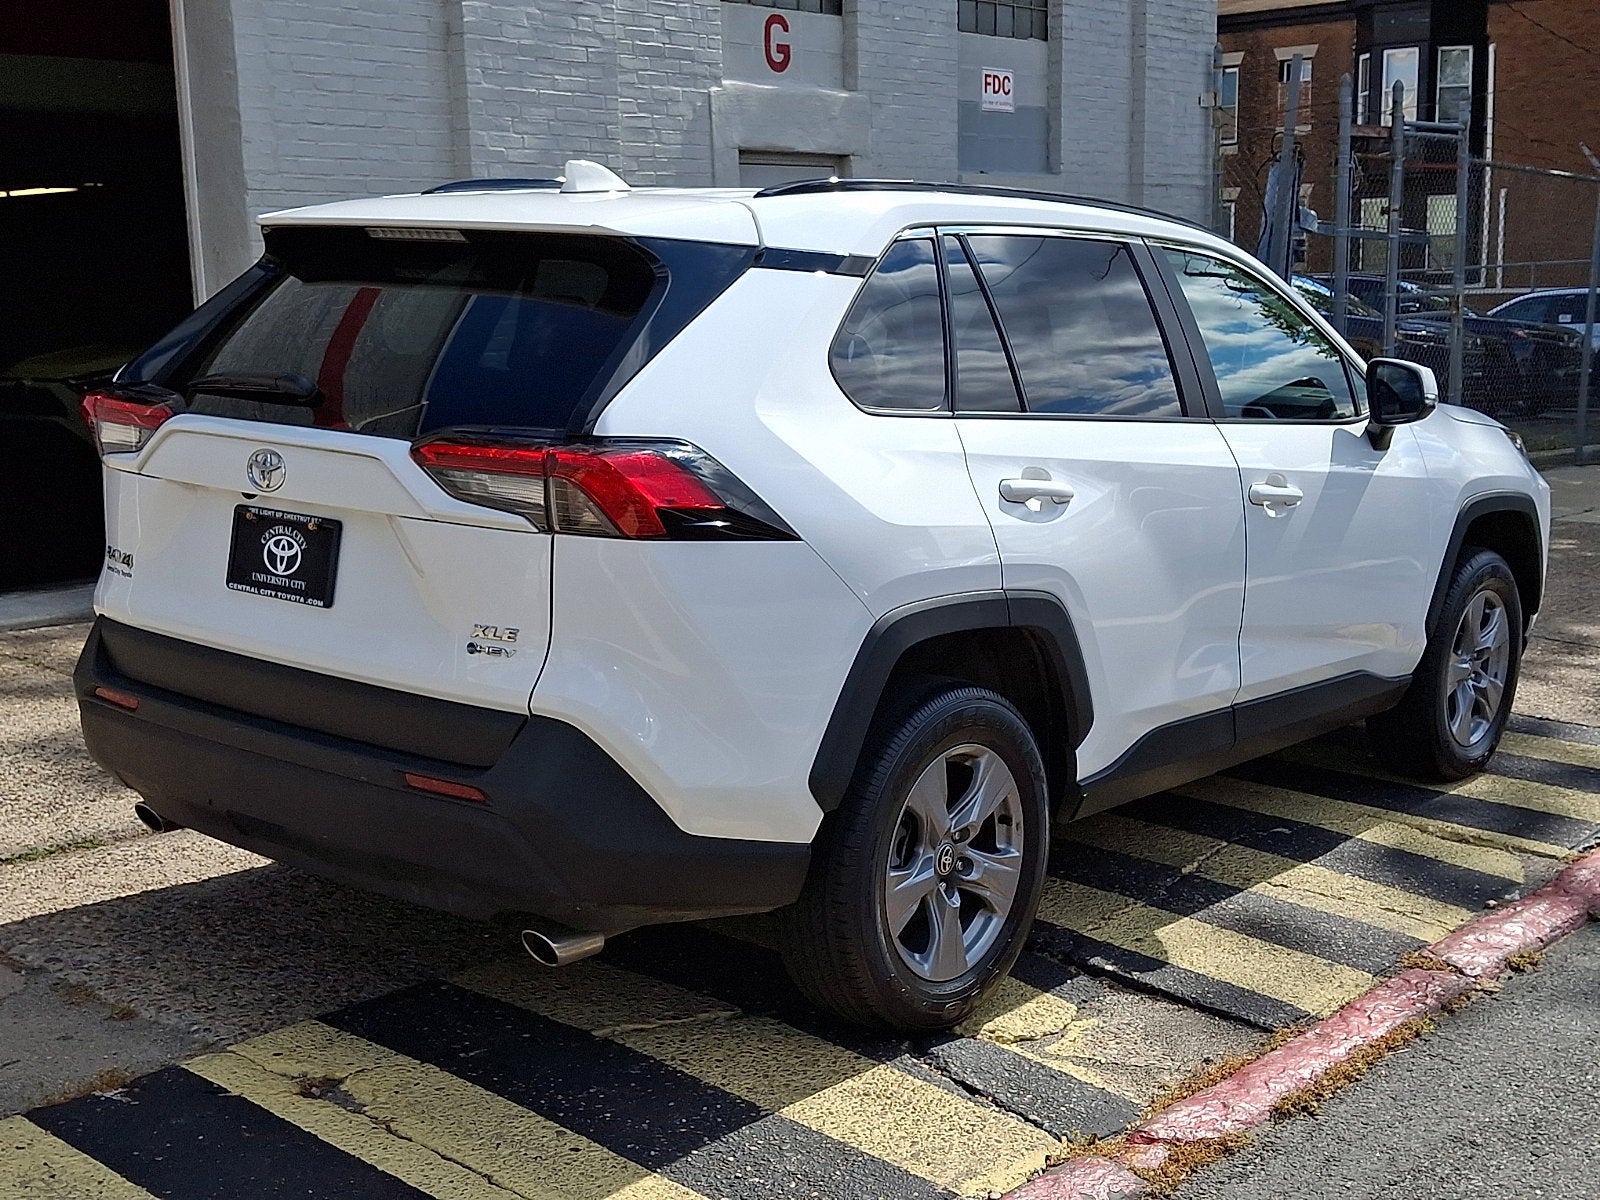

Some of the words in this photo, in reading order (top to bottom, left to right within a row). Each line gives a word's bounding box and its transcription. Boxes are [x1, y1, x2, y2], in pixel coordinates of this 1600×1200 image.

[764, 13, 791, 73] G
[984, 73, 1011, 96] FDC
[259, 509, 275, 517] LIGHT
[283, 513, 311, 522] CHESTNUT
[260, 525, 292, 544] CENTRAL
[291, 530, 308, 550] CITY
[252, 572, 290, 587] UNIVERSITY
[290, 580, 307, 590] CITY
[228, 582, 258, 593] CENTRAL
[259, 588, 276, 598] CITY
[277, 592, 304, 603] TOYOTA
[470, 623, 520, 642] XLE
